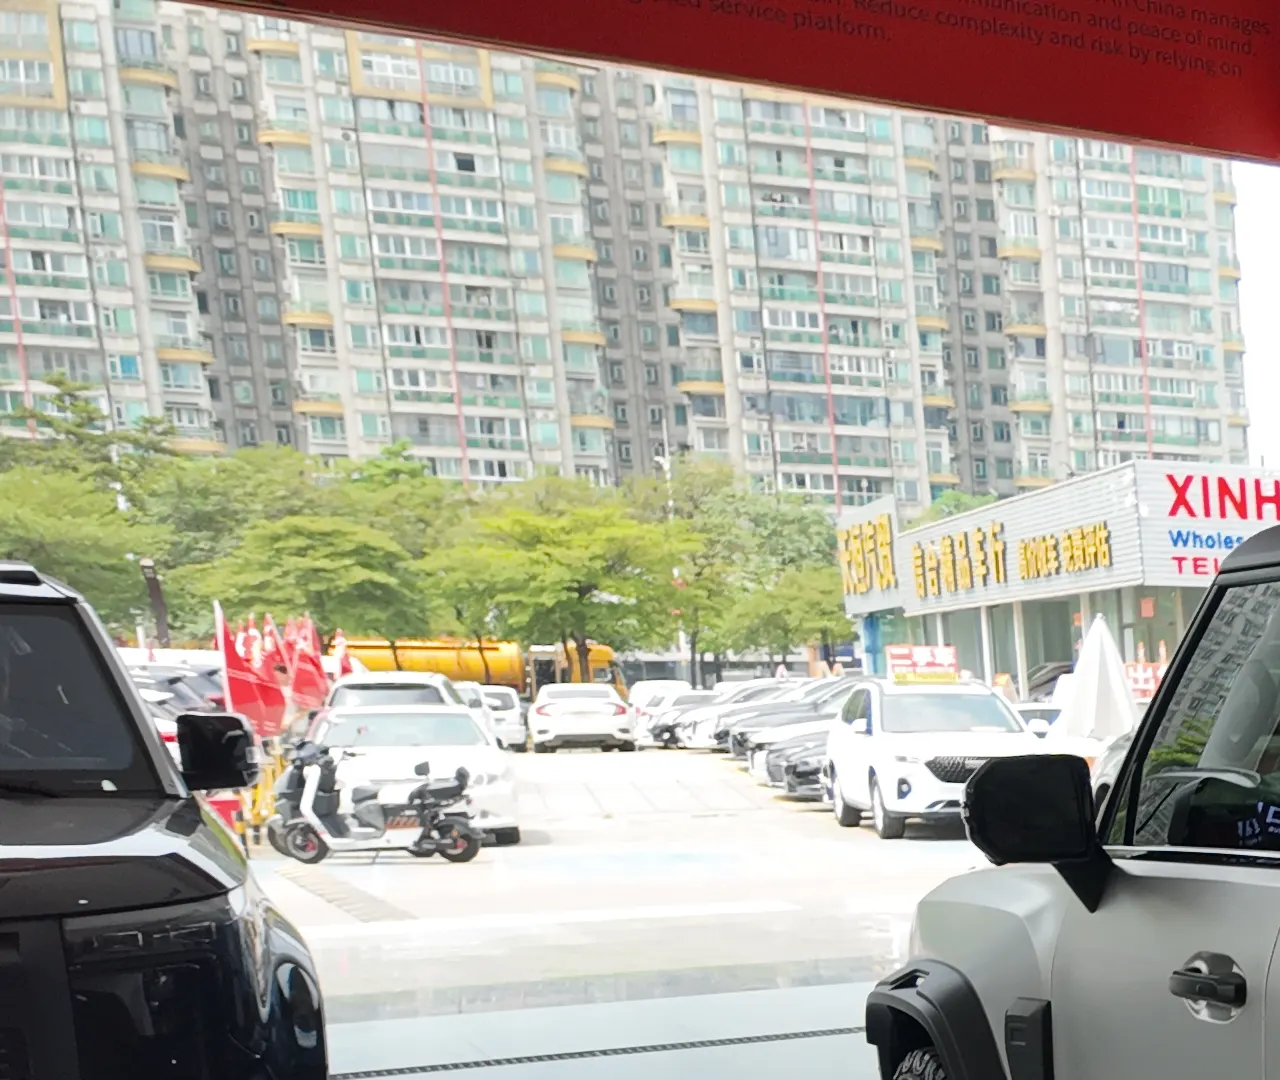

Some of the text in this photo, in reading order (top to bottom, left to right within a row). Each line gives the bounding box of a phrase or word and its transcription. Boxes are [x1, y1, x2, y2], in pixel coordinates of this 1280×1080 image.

[793, 12, 891, 41] platform.
[1087, 14, 1121, 33] and
[1127, 20, 1182, 46] peace
[1186, 30, 1203, 46] of
[1207, 35, 1257, 57] mind.
[1191, 9, 1271, 36] manages
[935, 11, 1044, 45] complexity
[1050, 30, 1085, 50] and
[1091, 37, 1124, 57] risk
[1129, 42, 1151, 64] by
[1155, 47, 1216, 77] relying
[1221, 60, 1243, 77] on
